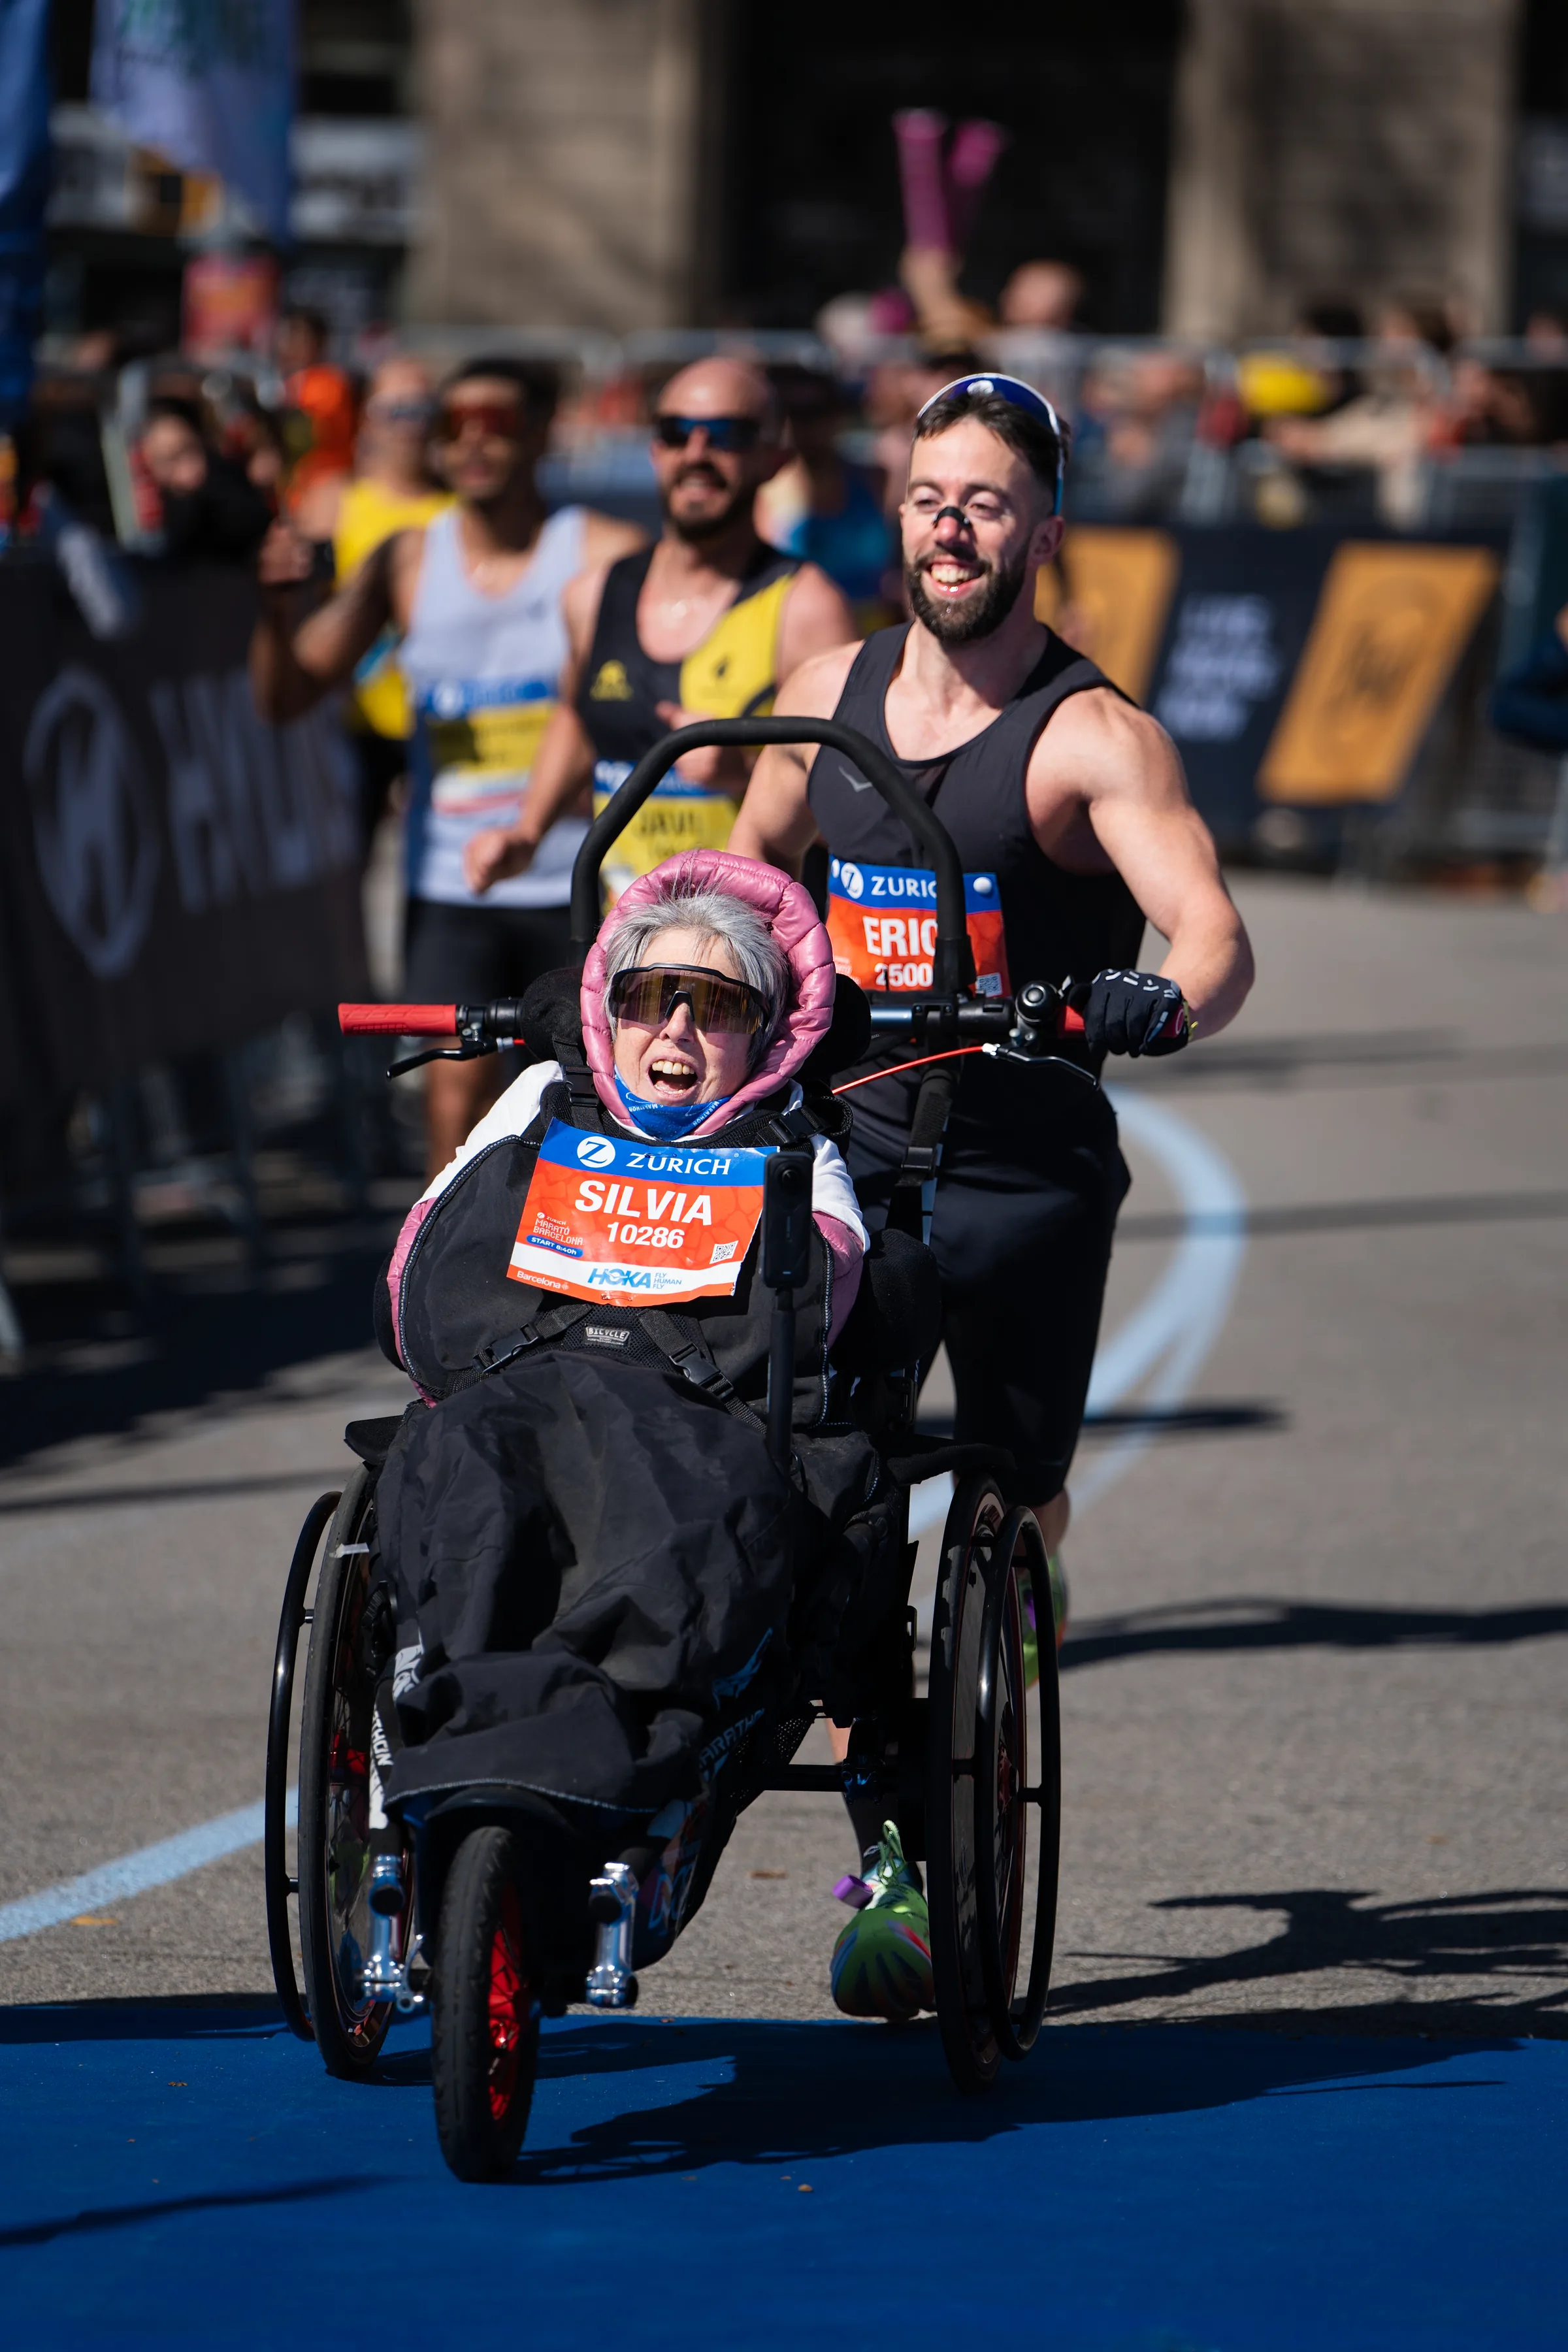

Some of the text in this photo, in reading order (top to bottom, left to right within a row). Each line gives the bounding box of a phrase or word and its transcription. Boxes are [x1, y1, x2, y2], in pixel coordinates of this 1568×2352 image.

[871, 876, 938, 898] ZURIC
[874, 962, 933, 987] 2500
[693, 1101, 720, 1128] MARATHON
[626, 1152, 732, 1175] ZURICH
[575, 1180, 713, 1226] SILVIA
[535, 1218, 570, 1235] MARATÓ
[546, 1216, 566, 1226] ZURICH
[531, 1237, 577, 1255] START 8:40h
[532, 1225, 583, 1246] BARCELONA
[607, 1222, 684, 1249] 10286
[517, 1270, 561, 1289] Barcelona
[587, 1267, 651, 1289] HOKA
[587, 1327, 627, 1339] BICYCLE
